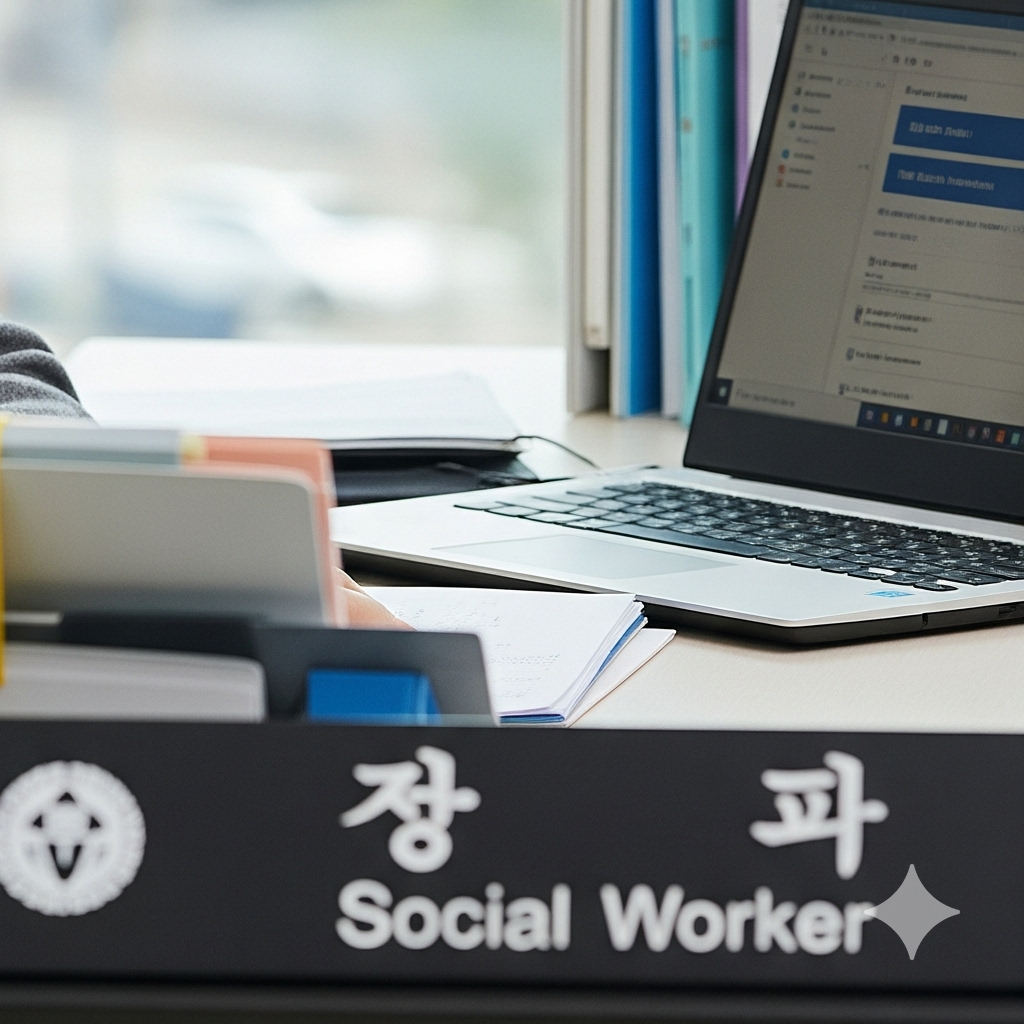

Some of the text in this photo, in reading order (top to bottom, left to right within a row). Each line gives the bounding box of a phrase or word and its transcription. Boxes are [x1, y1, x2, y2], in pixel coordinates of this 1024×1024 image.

[340, 745, 889, 880] 장 파
[335, 878, 877, 955] Social Worker
